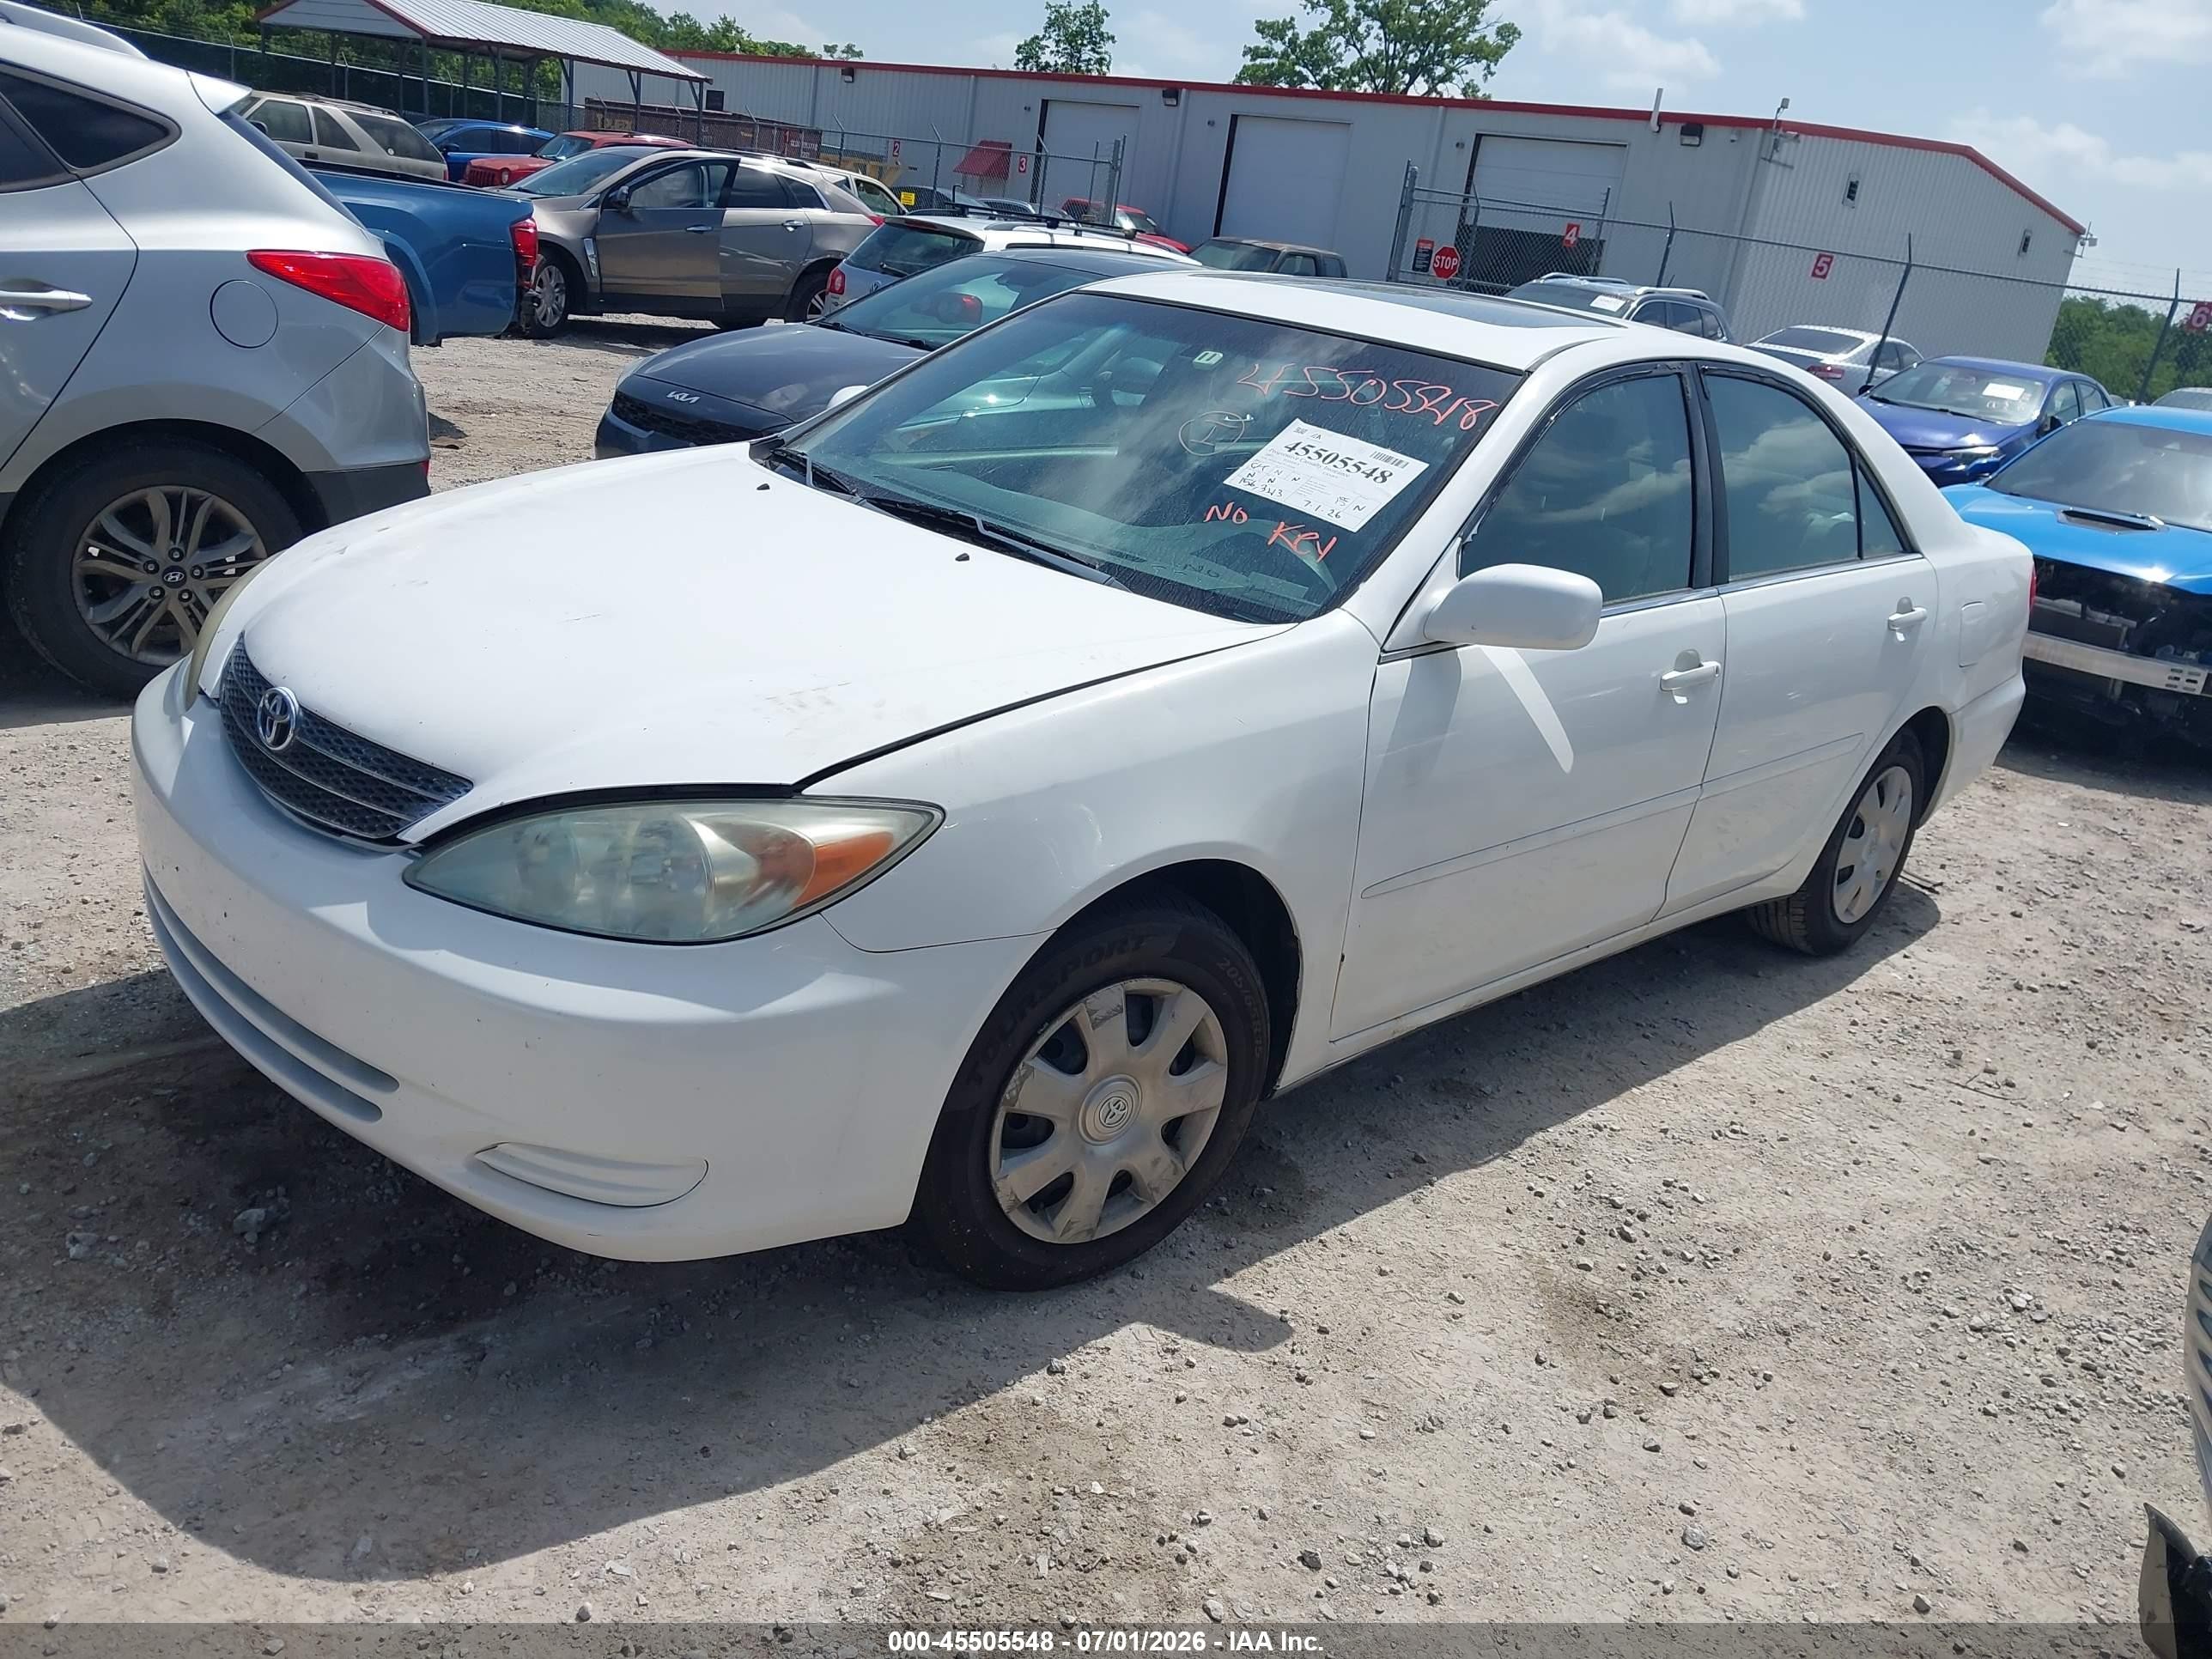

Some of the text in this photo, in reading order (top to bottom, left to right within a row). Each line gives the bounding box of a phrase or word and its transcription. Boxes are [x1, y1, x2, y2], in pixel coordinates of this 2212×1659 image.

[893, 143, 899, 155] 2
[1019, 158, 1026, 171] 3
[1565, 226, 1578, 245] 4
[1434, 255, 1458, 270] STOP
[1814, 257, 1832, 276] 5
[1237, 362, 1499, 430] 45505548
[1284, 441, 1394, 484] 45505548
